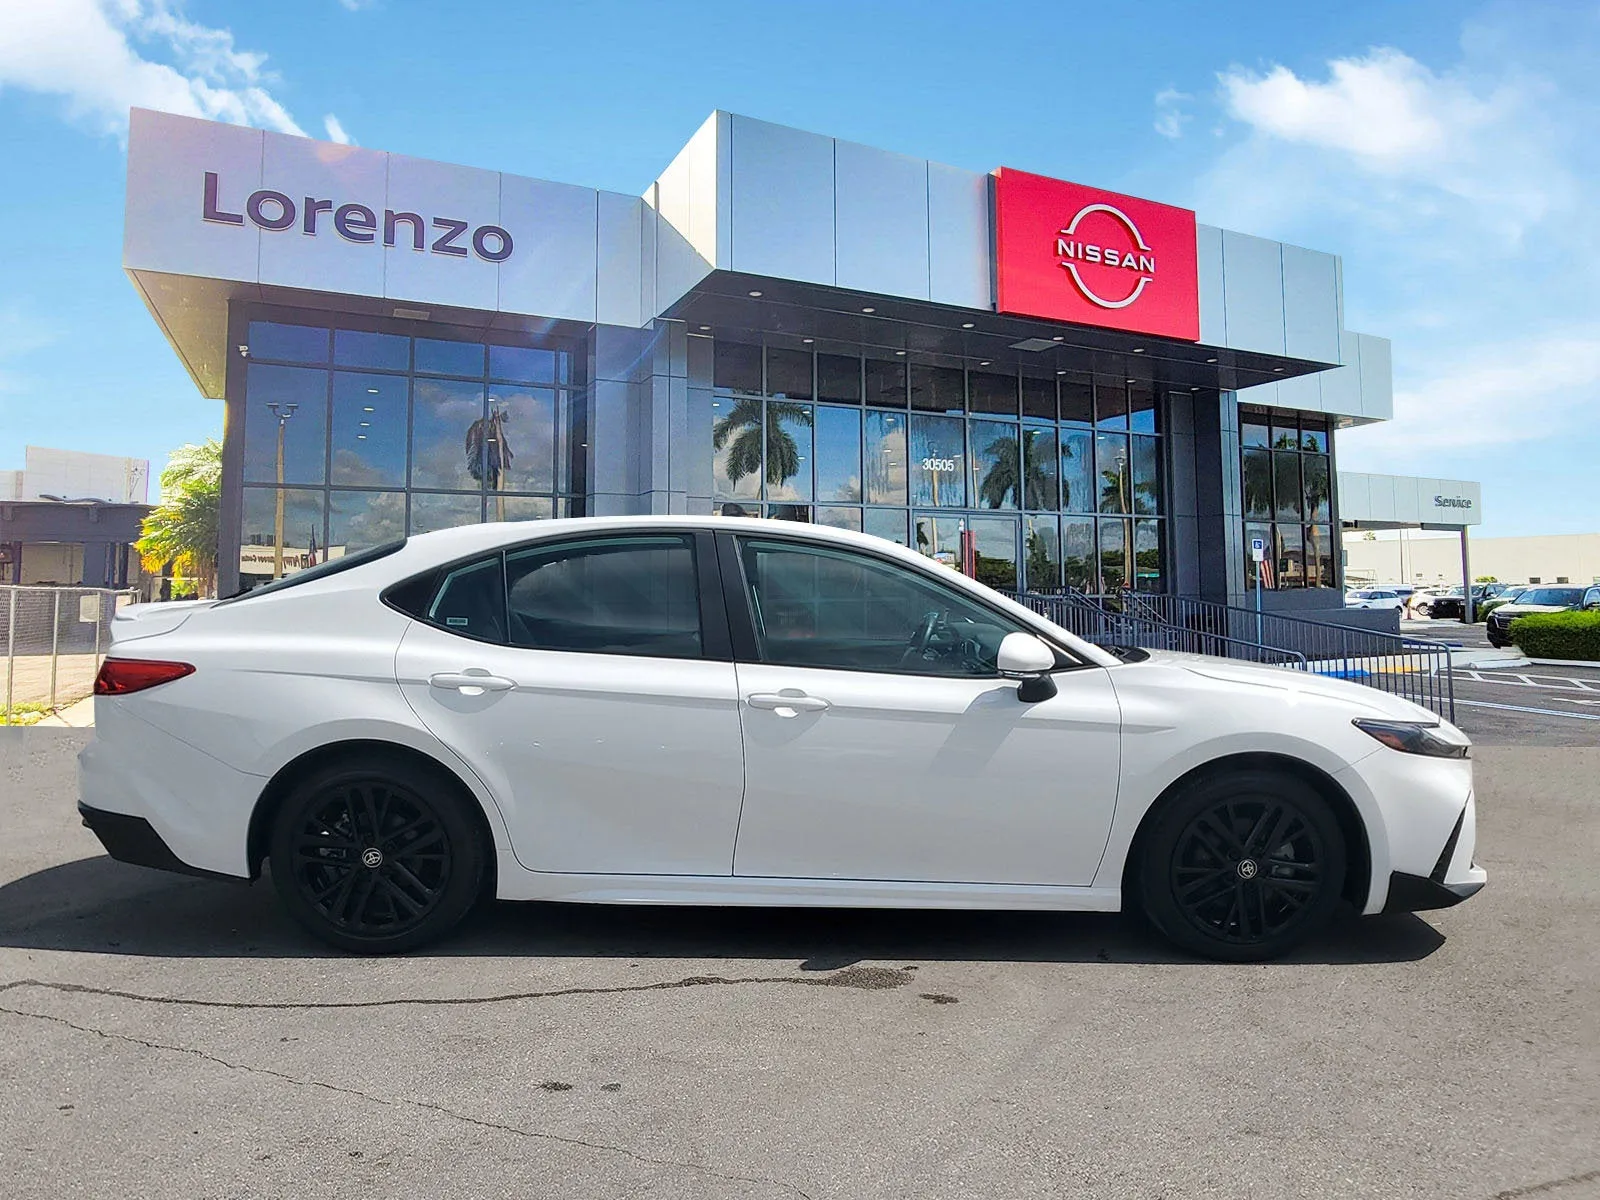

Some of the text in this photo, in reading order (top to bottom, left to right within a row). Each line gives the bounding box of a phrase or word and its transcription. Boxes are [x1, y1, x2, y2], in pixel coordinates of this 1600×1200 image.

[202, 171, 515, 262] Lorenzo
[1057, 238, 1155, 273] NISSAN
[922, 458, 955, 472] 30505
[1434, 495, 1472, 508] Service
